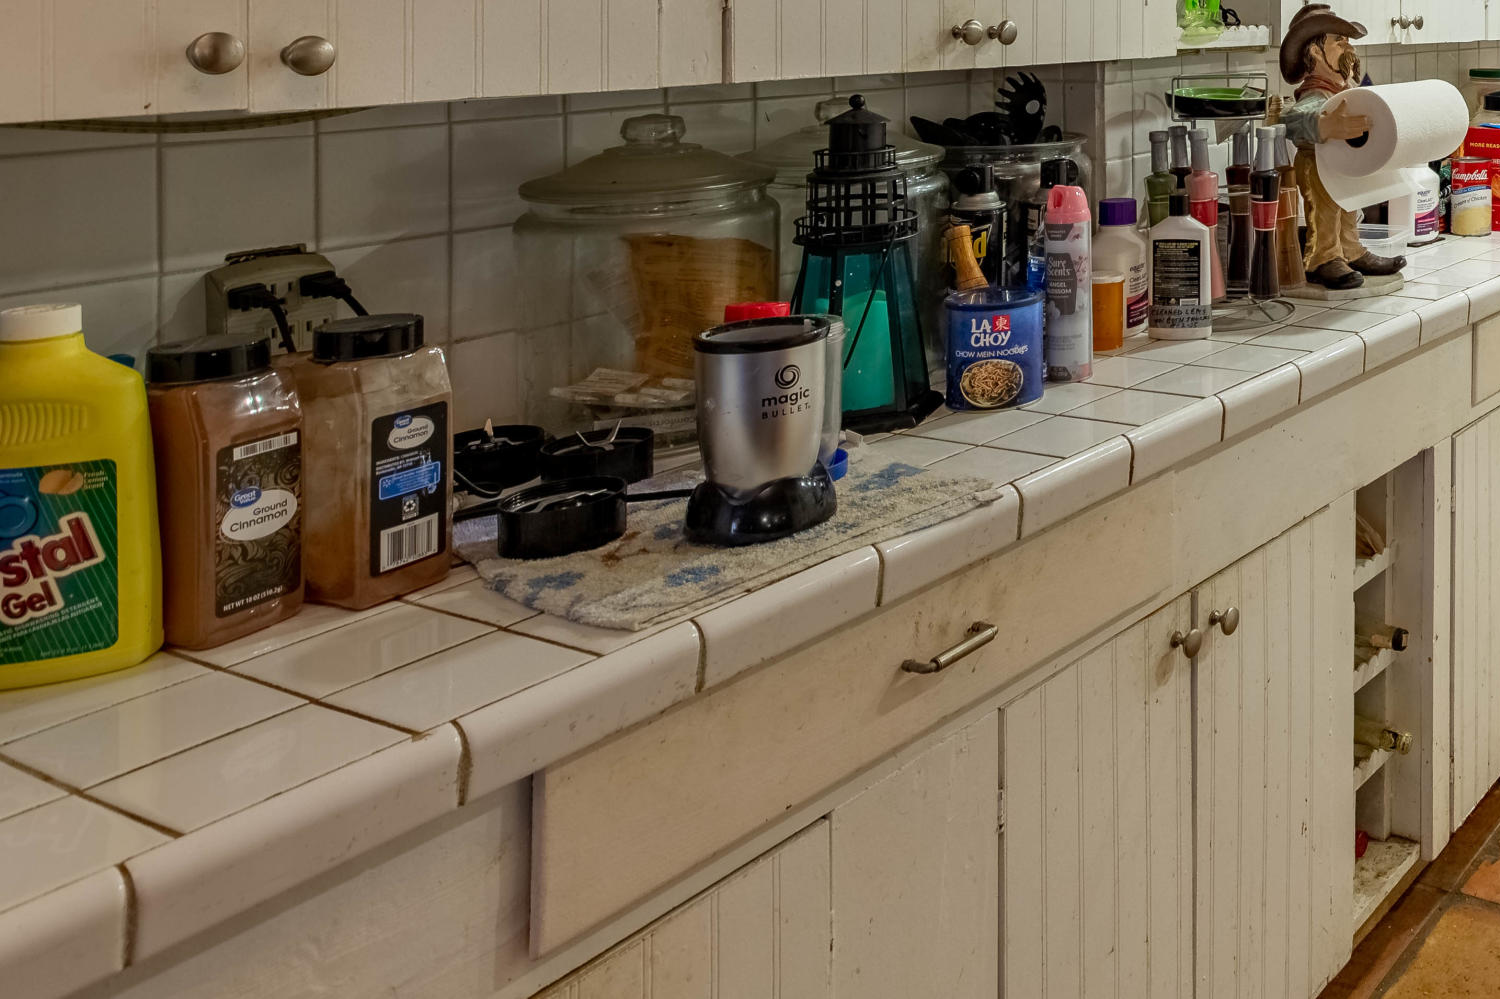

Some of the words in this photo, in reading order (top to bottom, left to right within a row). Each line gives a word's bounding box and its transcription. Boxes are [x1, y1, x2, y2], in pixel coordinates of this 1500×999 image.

[1048, 256, 1067, 269] Sure
[971, 318, 991, 333] LA
[995, 316, 1009, 331] 東
[970, 331, 1011, 347] CHOY
[955, 350, 976, 358] CHOW
[976, 350, 995, 358] MEIN
[997, 344, 1029, 357] NOODLES
[761, 386, 810, 407] magic
[762, 402, 809, 419] BULLET
[407, 424, 428, 433] Ground
[393, 430, 428, 443] Cinnamon
[234, 490, 256, 502] Great
[252, 499, 288, 516] Ground
[229, 508, 288, 533] Cinnamon
[1, 580, 57, 620] Gel
[223, 602, 235, 611] NET
